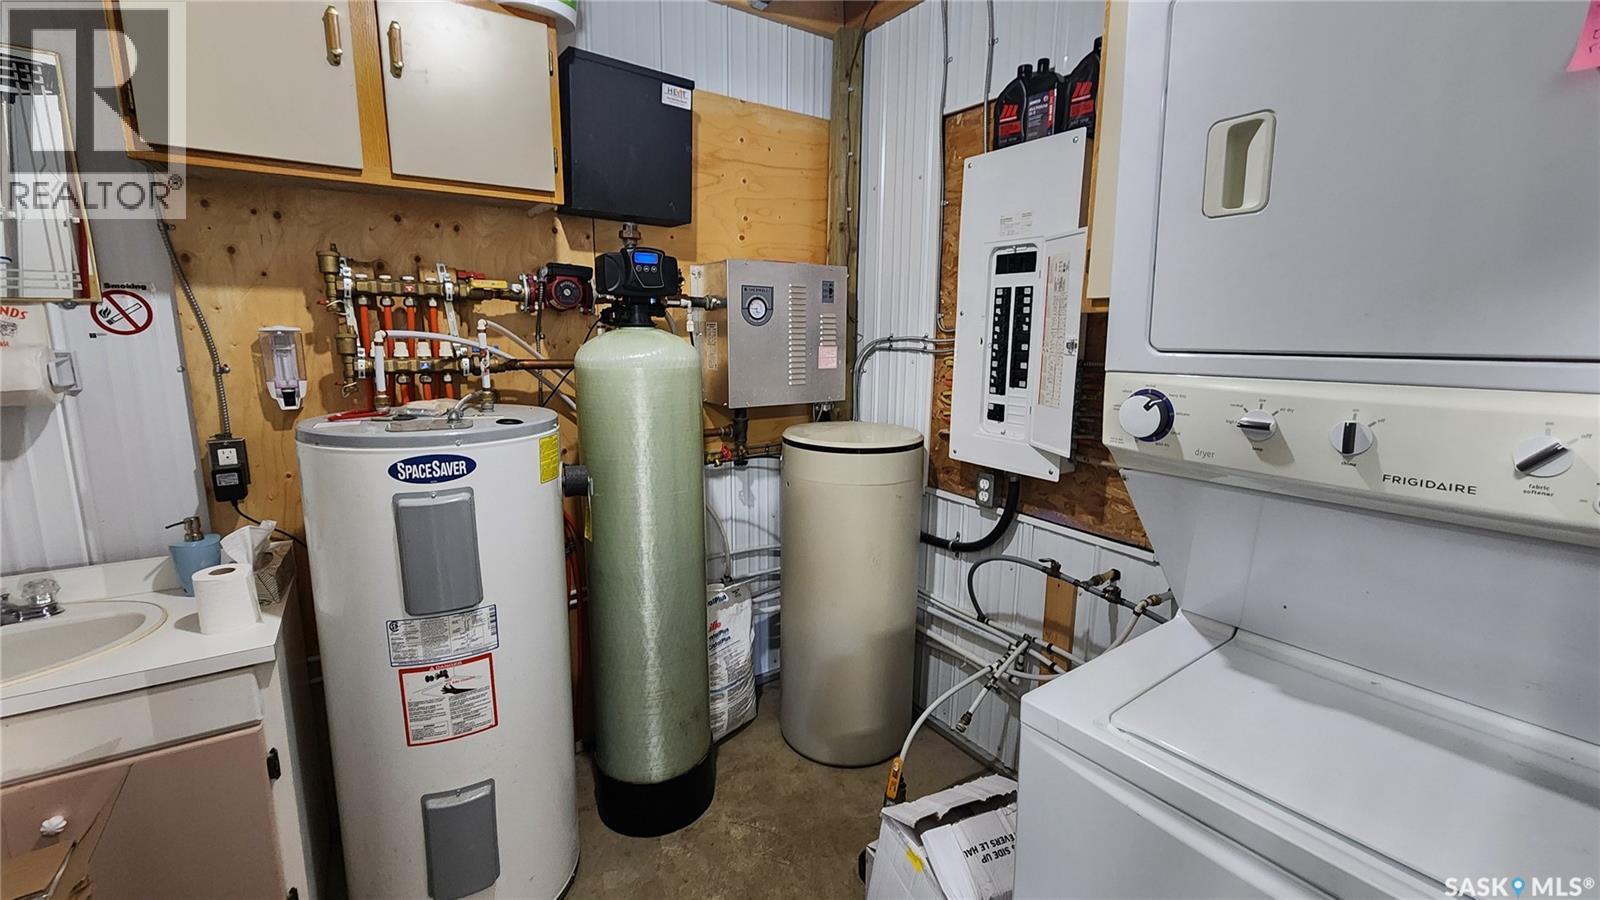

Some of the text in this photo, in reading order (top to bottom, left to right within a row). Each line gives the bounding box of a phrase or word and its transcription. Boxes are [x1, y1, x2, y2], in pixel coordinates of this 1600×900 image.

[1194, 449, 1216, 460] dryer
[1382, 473, 1478, 496] FRIGIDAIRE
[1528, 483, 1551, 492] fabric
[1523, 489, 1555, 497] softener
[979, 841, 990, 852] LE
[981, 846, 1011, 864] SIDE UP
